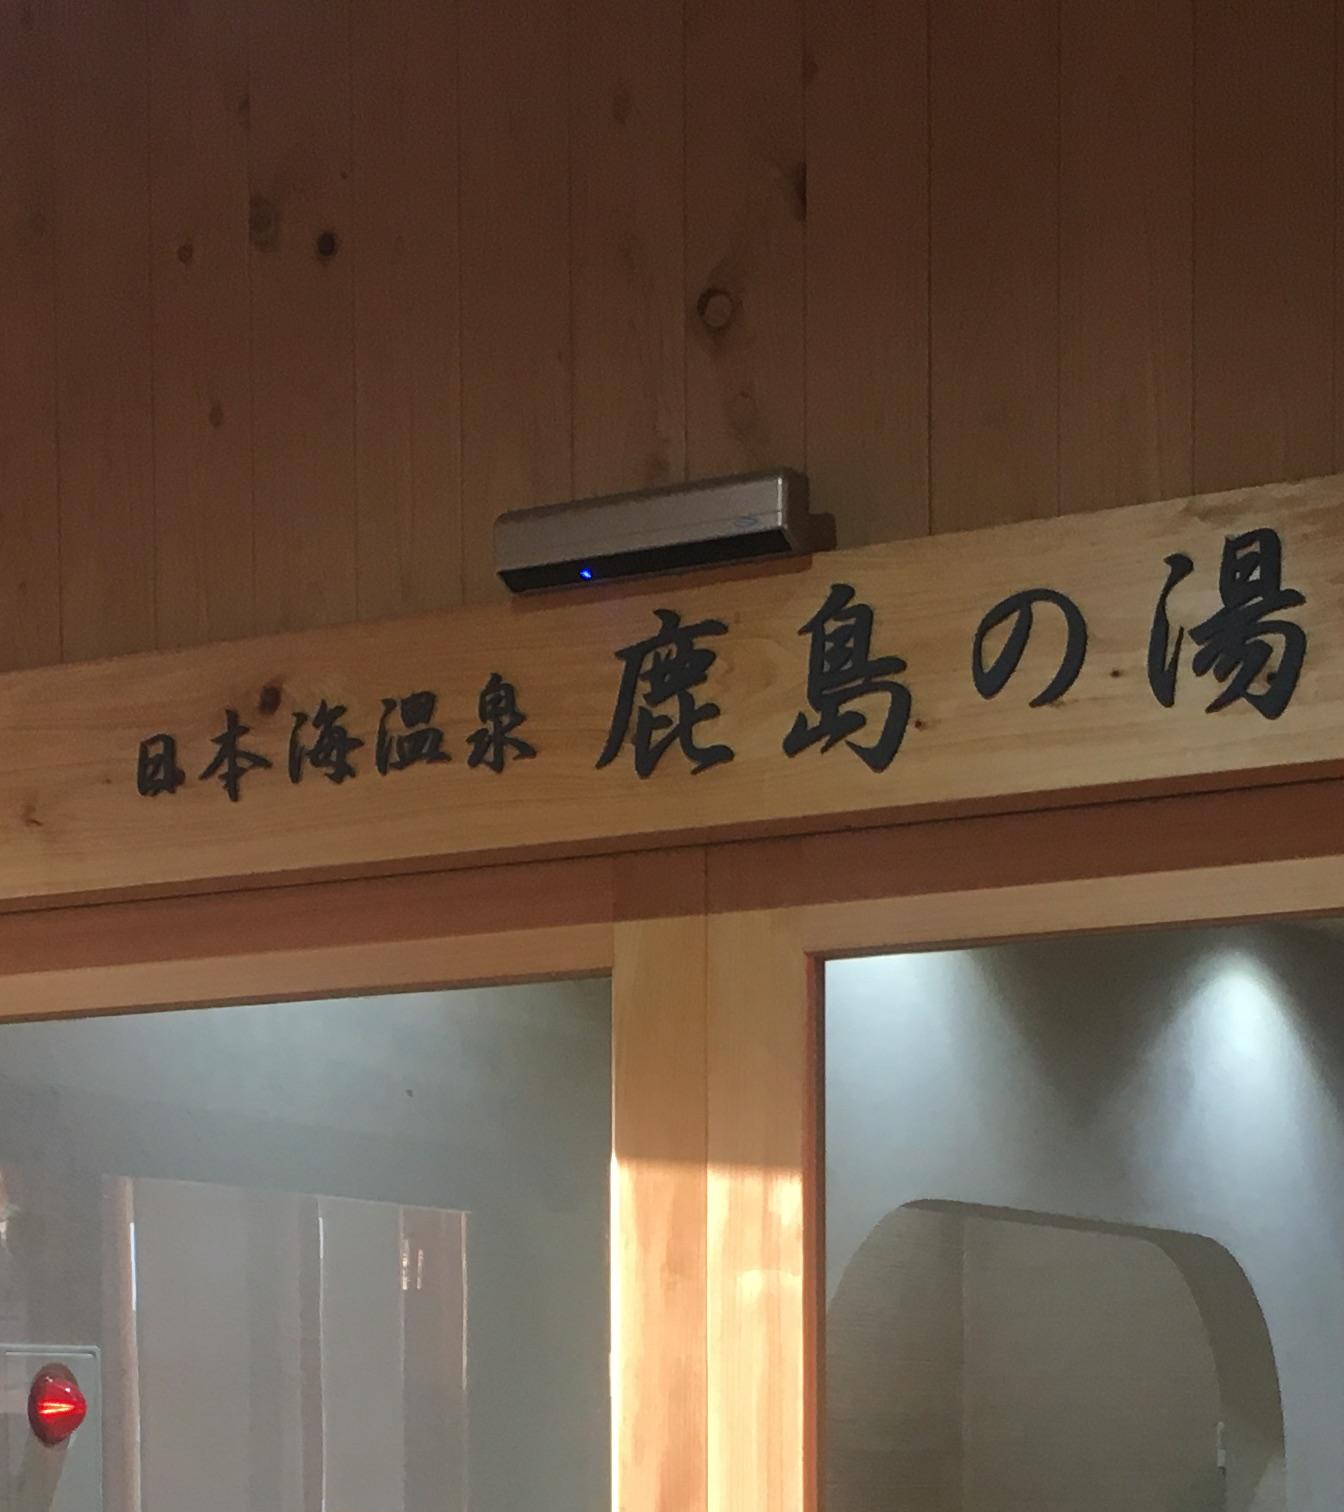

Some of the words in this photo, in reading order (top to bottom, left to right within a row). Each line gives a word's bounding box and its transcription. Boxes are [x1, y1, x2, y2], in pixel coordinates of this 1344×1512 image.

[135, 673, 537, 801] 日本海温泉
[594, 527, 1307, 778] 鹿島の湯
